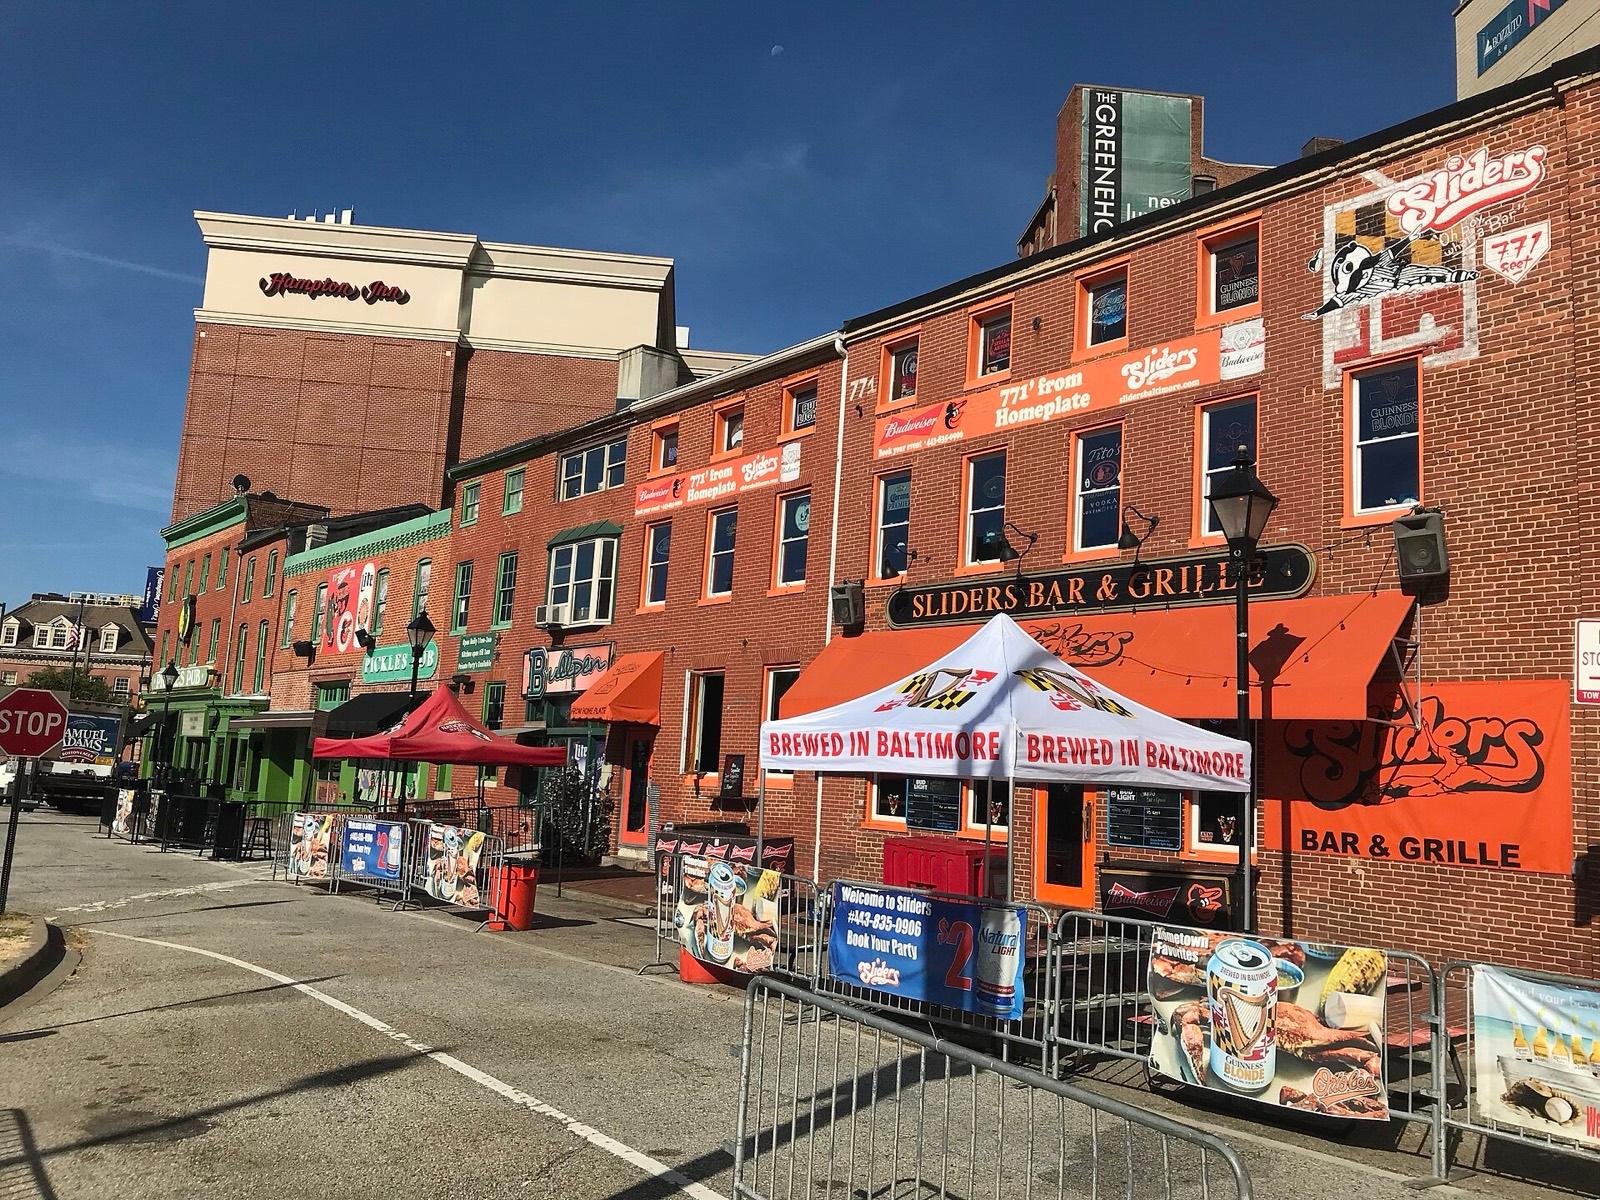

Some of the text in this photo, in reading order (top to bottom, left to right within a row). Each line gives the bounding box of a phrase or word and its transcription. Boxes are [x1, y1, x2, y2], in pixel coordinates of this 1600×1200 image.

[1096, 92, 1117, 104] THE
[1385, 144, 1547, 234] Sliders
[1490, 230, 1543, 264] 771
[259, 272, 411, 305] Hampton Inn
[1220, 276, 1258, 293] GUINNESS
[1120, 346, 1199, 390] Sliders
[1221, 351, 1264, 368] Budweiser
[849, 375, 877, 401] 771
[999, 371, 1083, 408] 771' from
[994, 391, 1091, 428] Homeplate
[1370, 400, 1419, 419] GUINNESS
[1371, 411, 1419, 432] BLONDE
[884, 416, 938, 438] Budweiser
[1088, 443, 1122, 464] Tito's
[709, 466, 733, 483] from
[741, 454, 779, 483] Sliders
[687, 481, 737, 503] Homeplate
[1090, 497, 1118, 508] VODKA
[912, 553, 1265, 619] SLIDERS BAR & GRILLE
[364, 652, 408, 674] PICKLES
[527, 646, 607, 700] Bullpen
[185, 669, 202, 685] PUB
[0, 708, 62, 737] STOP
[64, 728, 108, 742] AMUEL
[575, 743, 588, 760] Lite
[769, 730, 1001, 761] BREWED IN BALTIMORE
[1027, 733, 1245, 779] BREWED IN BALTIMORE
[1284, 690, 1545, 811] Sliders
[1301, 828, 1522, 869] BAR & GRILLE
[842, 886, 884, 908] Welcome
[885, 894, 896, 910] to
[896, 895, 932, 916] Sliders
[847, 909, 922, 938] #443-835-0906
[846, 929, 918, 961] Book Your Party
[980, 926, 1019, 949] Natural
[936, 916, 974, 992] $2
[991, 945, 1017, 958] LIGHT
[857, 957, 900, 986] Sliders
[1539, 992, 1564, 1006] your
[1224, 1055, 1265, 1072] GUINNESS
[1224, 1064, 1265, 1081] BLONDE
